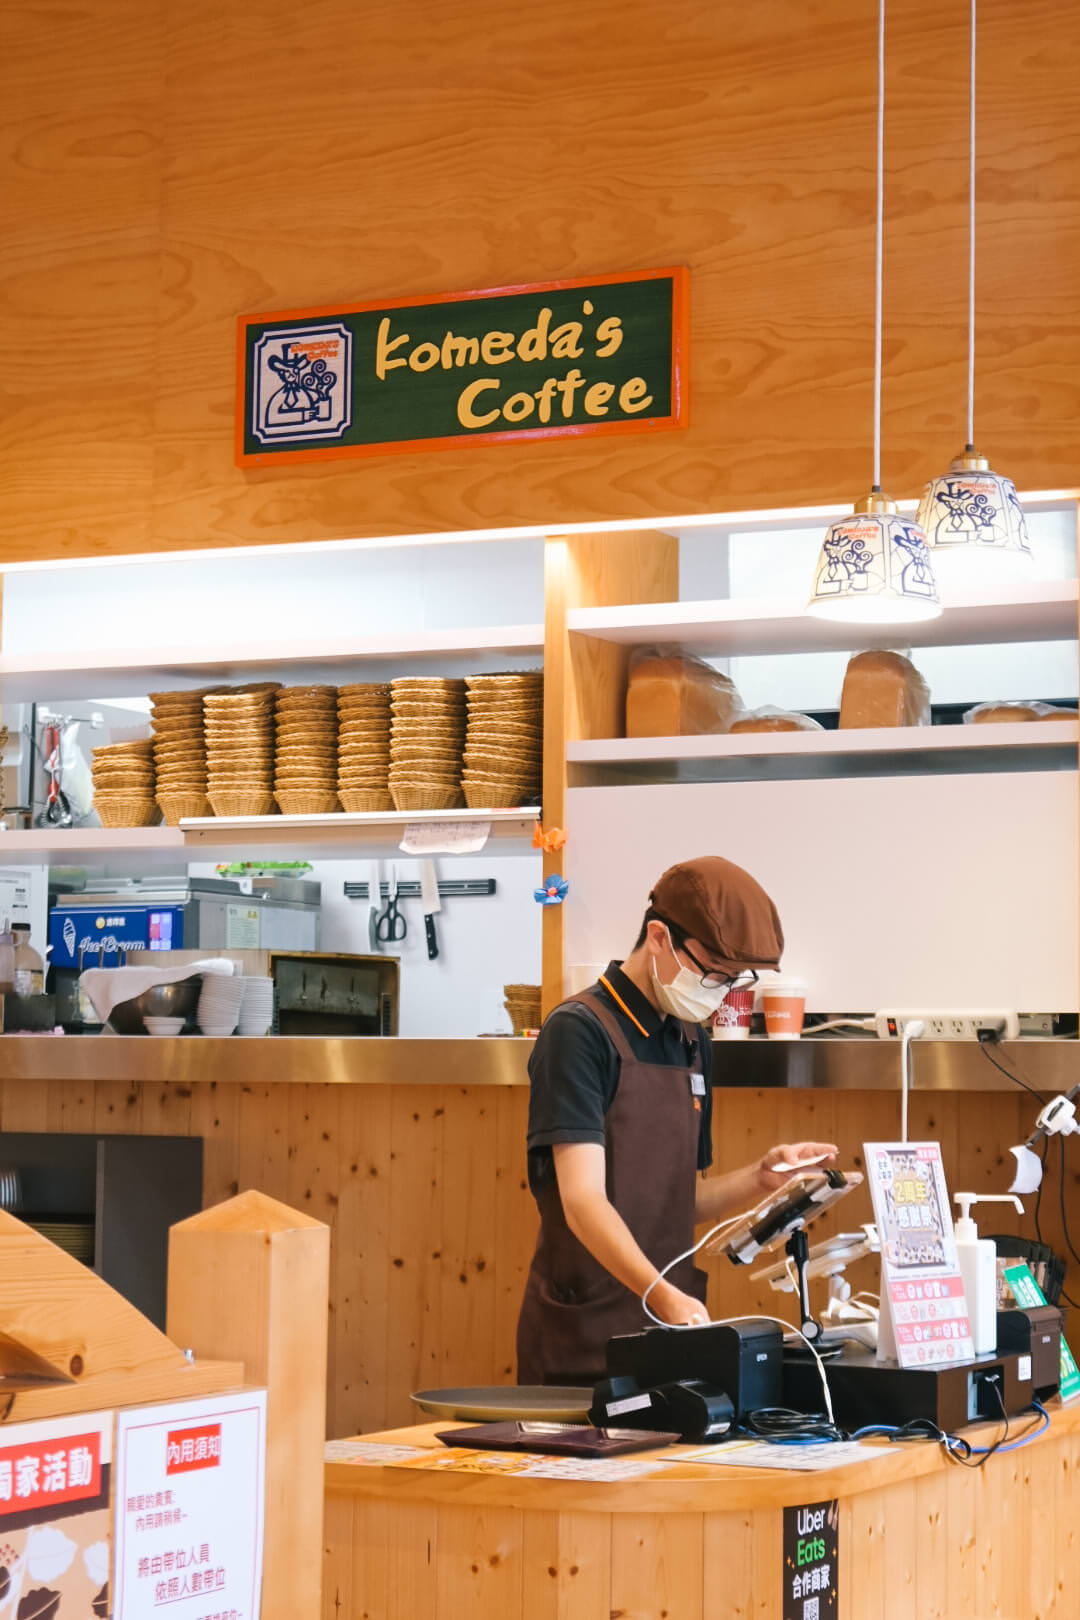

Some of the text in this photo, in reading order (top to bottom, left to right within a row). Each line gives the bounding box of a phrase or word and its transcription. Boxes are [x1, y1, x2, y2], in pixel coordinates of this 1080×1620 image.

[457, 369, 653, 429] Coffee
[797, 1508, 826, 1536] Uber
[797, 1536, 826, 1566] Eats
[792, 1564, 830, 1600] 合作商家
